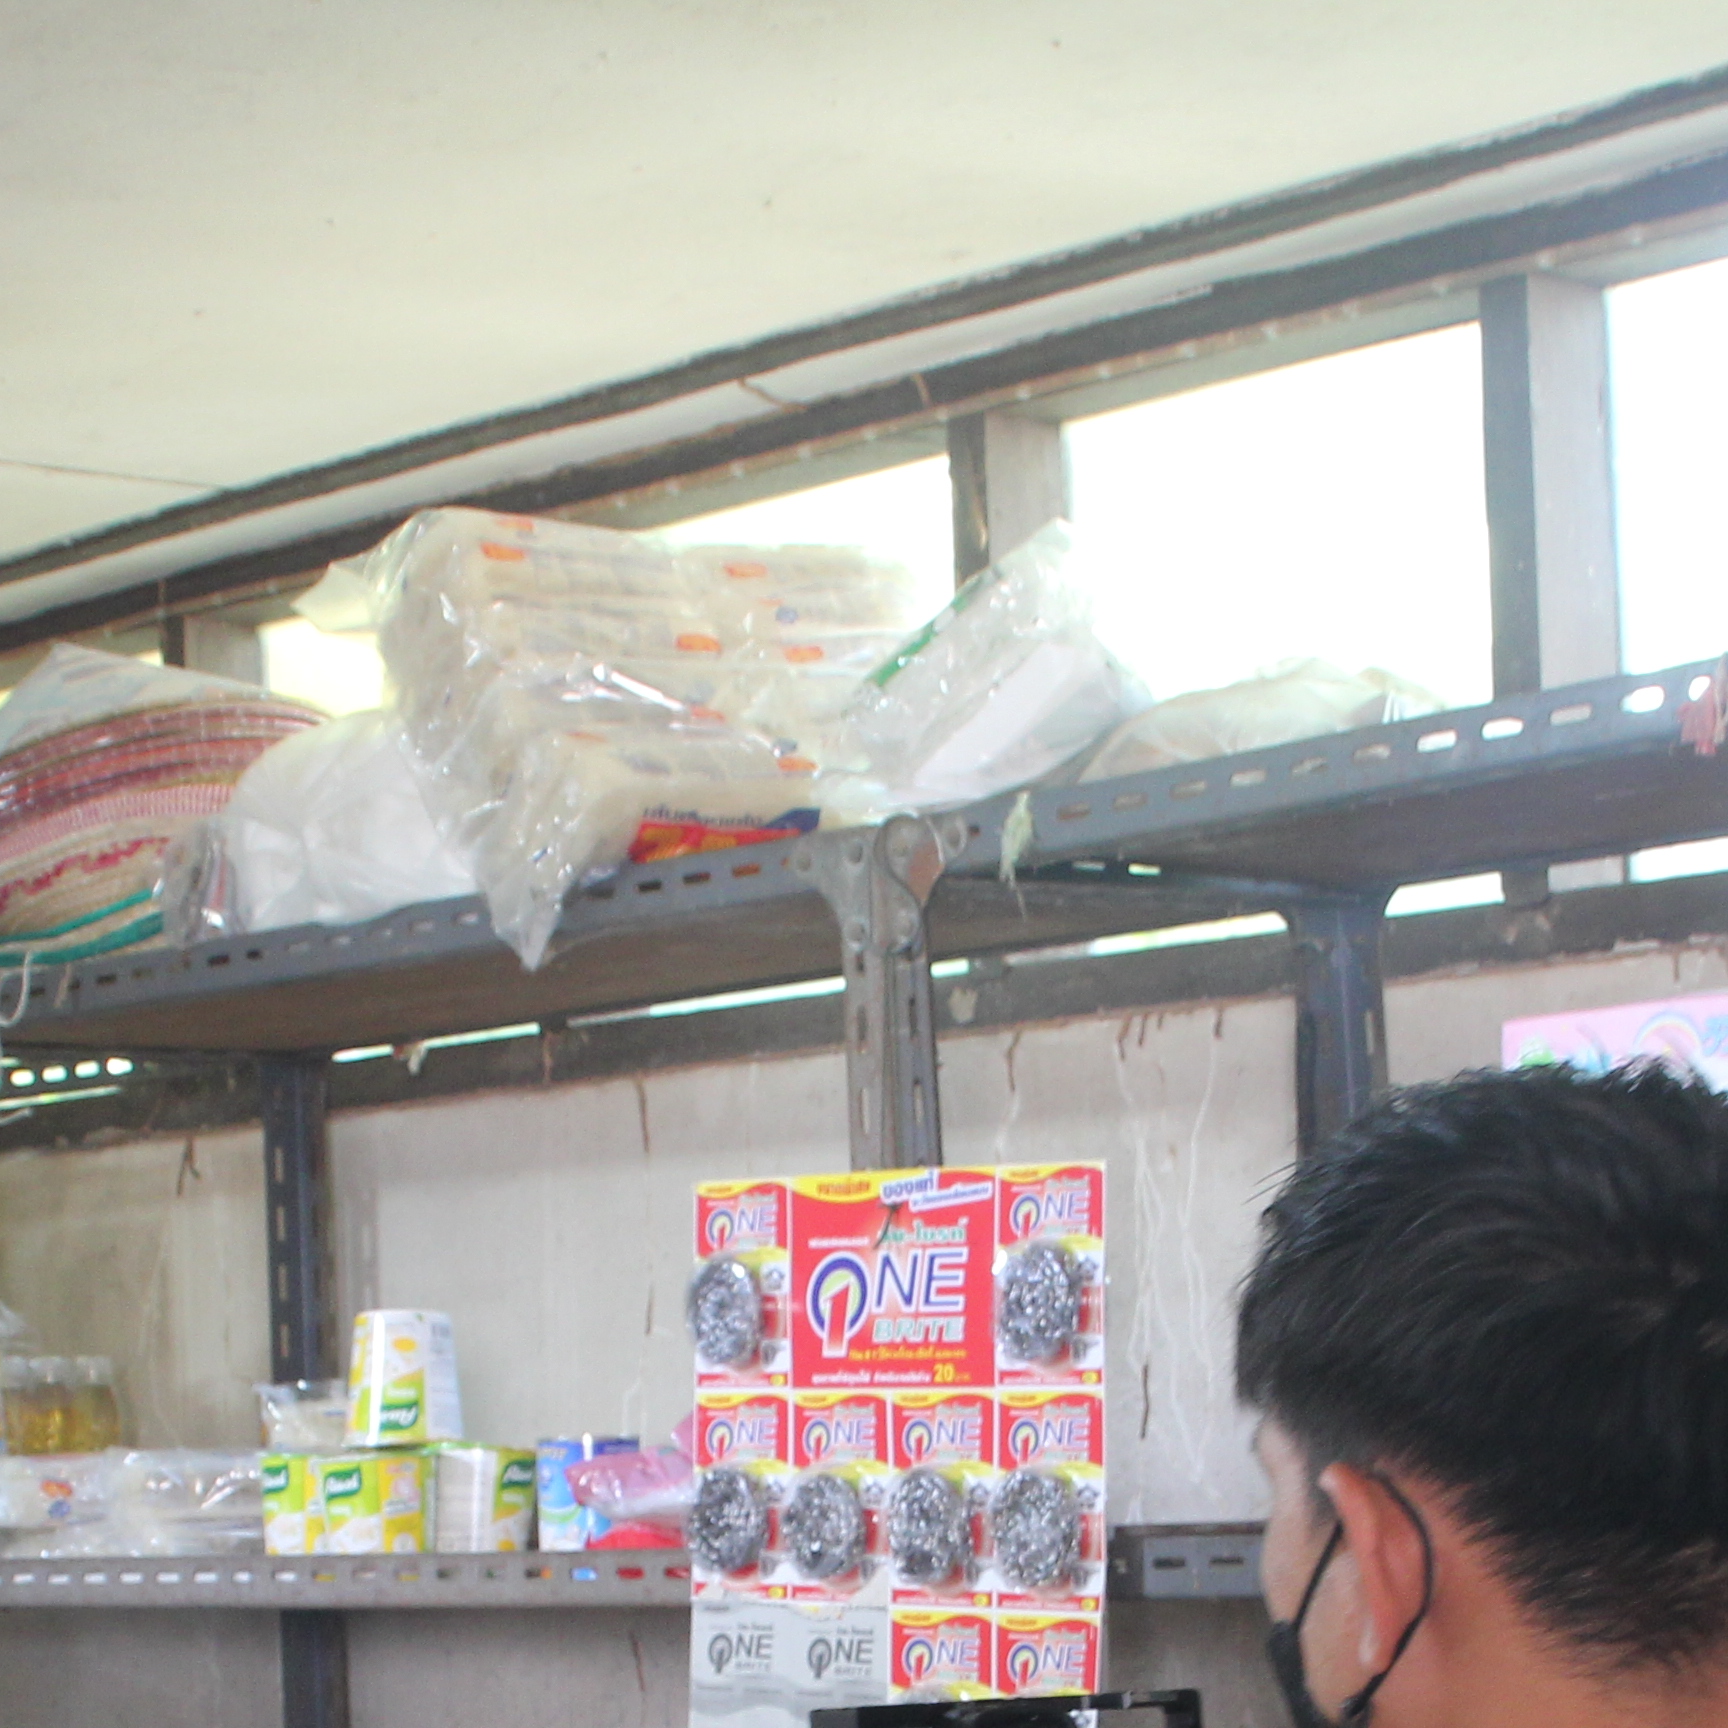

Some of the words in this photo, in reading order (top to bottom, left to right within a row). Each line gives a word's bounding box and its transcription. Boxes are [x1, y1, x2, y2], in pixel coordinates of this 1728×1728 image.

[706, 1202, 778, 1251] ONE
[1010, 1193, 1089, 1247] ONE
[807, 1247, 968, 1358] ONE
[873, 1316, 966, 1343] BRITE
[933, 1363, 956, 1384] 20
[706, 1417, 778, 1462] ONE
[802, 1417, 876, 1462] ONE
[903, 1417, 981, 1462] ONE
[1009, 1417, 1089, 1462] ONE
[707, 1631, 773, 1674] ONE
[807, 1638, 874, 1679] ONE
[902, 1638, 979, 1682] ONE
[1009, 1641, 1086, 1687] ONE
